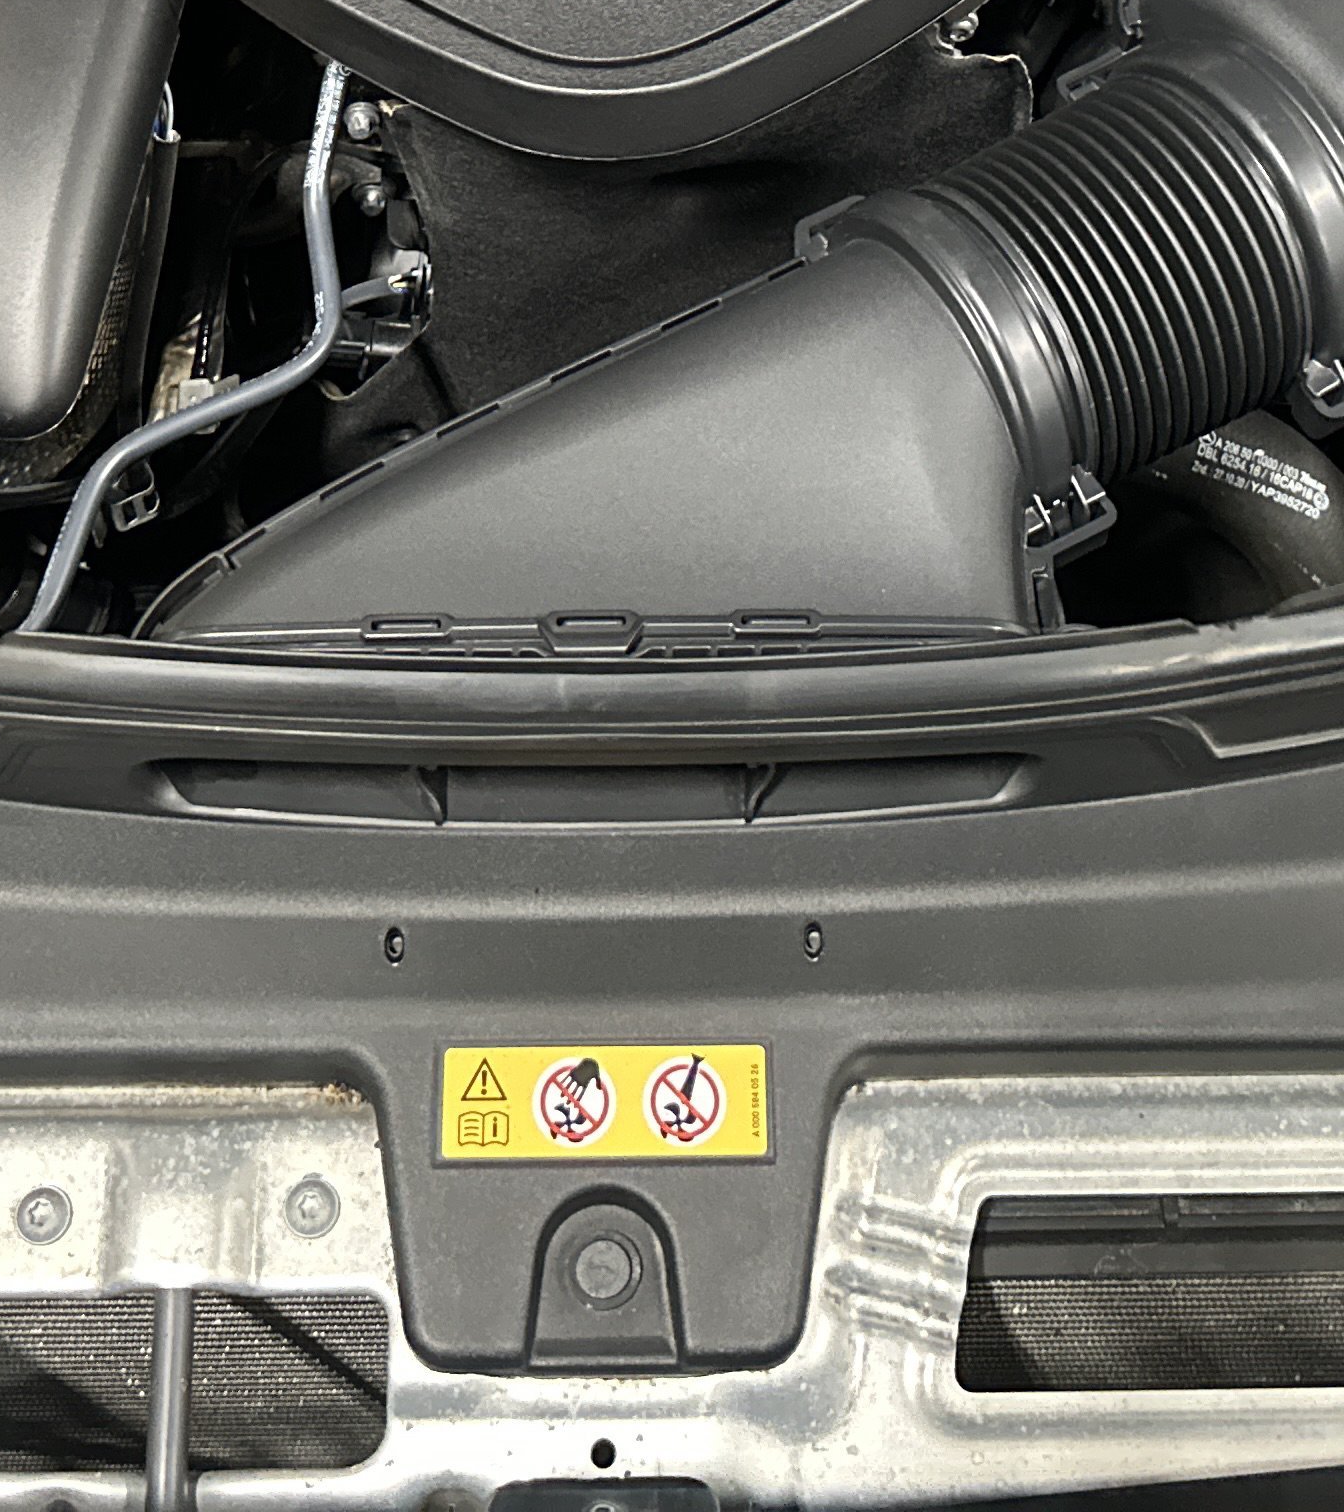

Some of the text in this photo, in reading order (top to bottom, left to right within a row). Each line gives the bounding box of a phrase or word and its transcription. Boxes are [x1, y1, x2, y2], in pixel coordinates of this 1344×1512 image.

[1214, 437, 1223, 449] A
[1197, 443, 1218, 463] DBL
[750, 1064, 759, 1076] 26
[752, 1111, 760, 1129] 000
